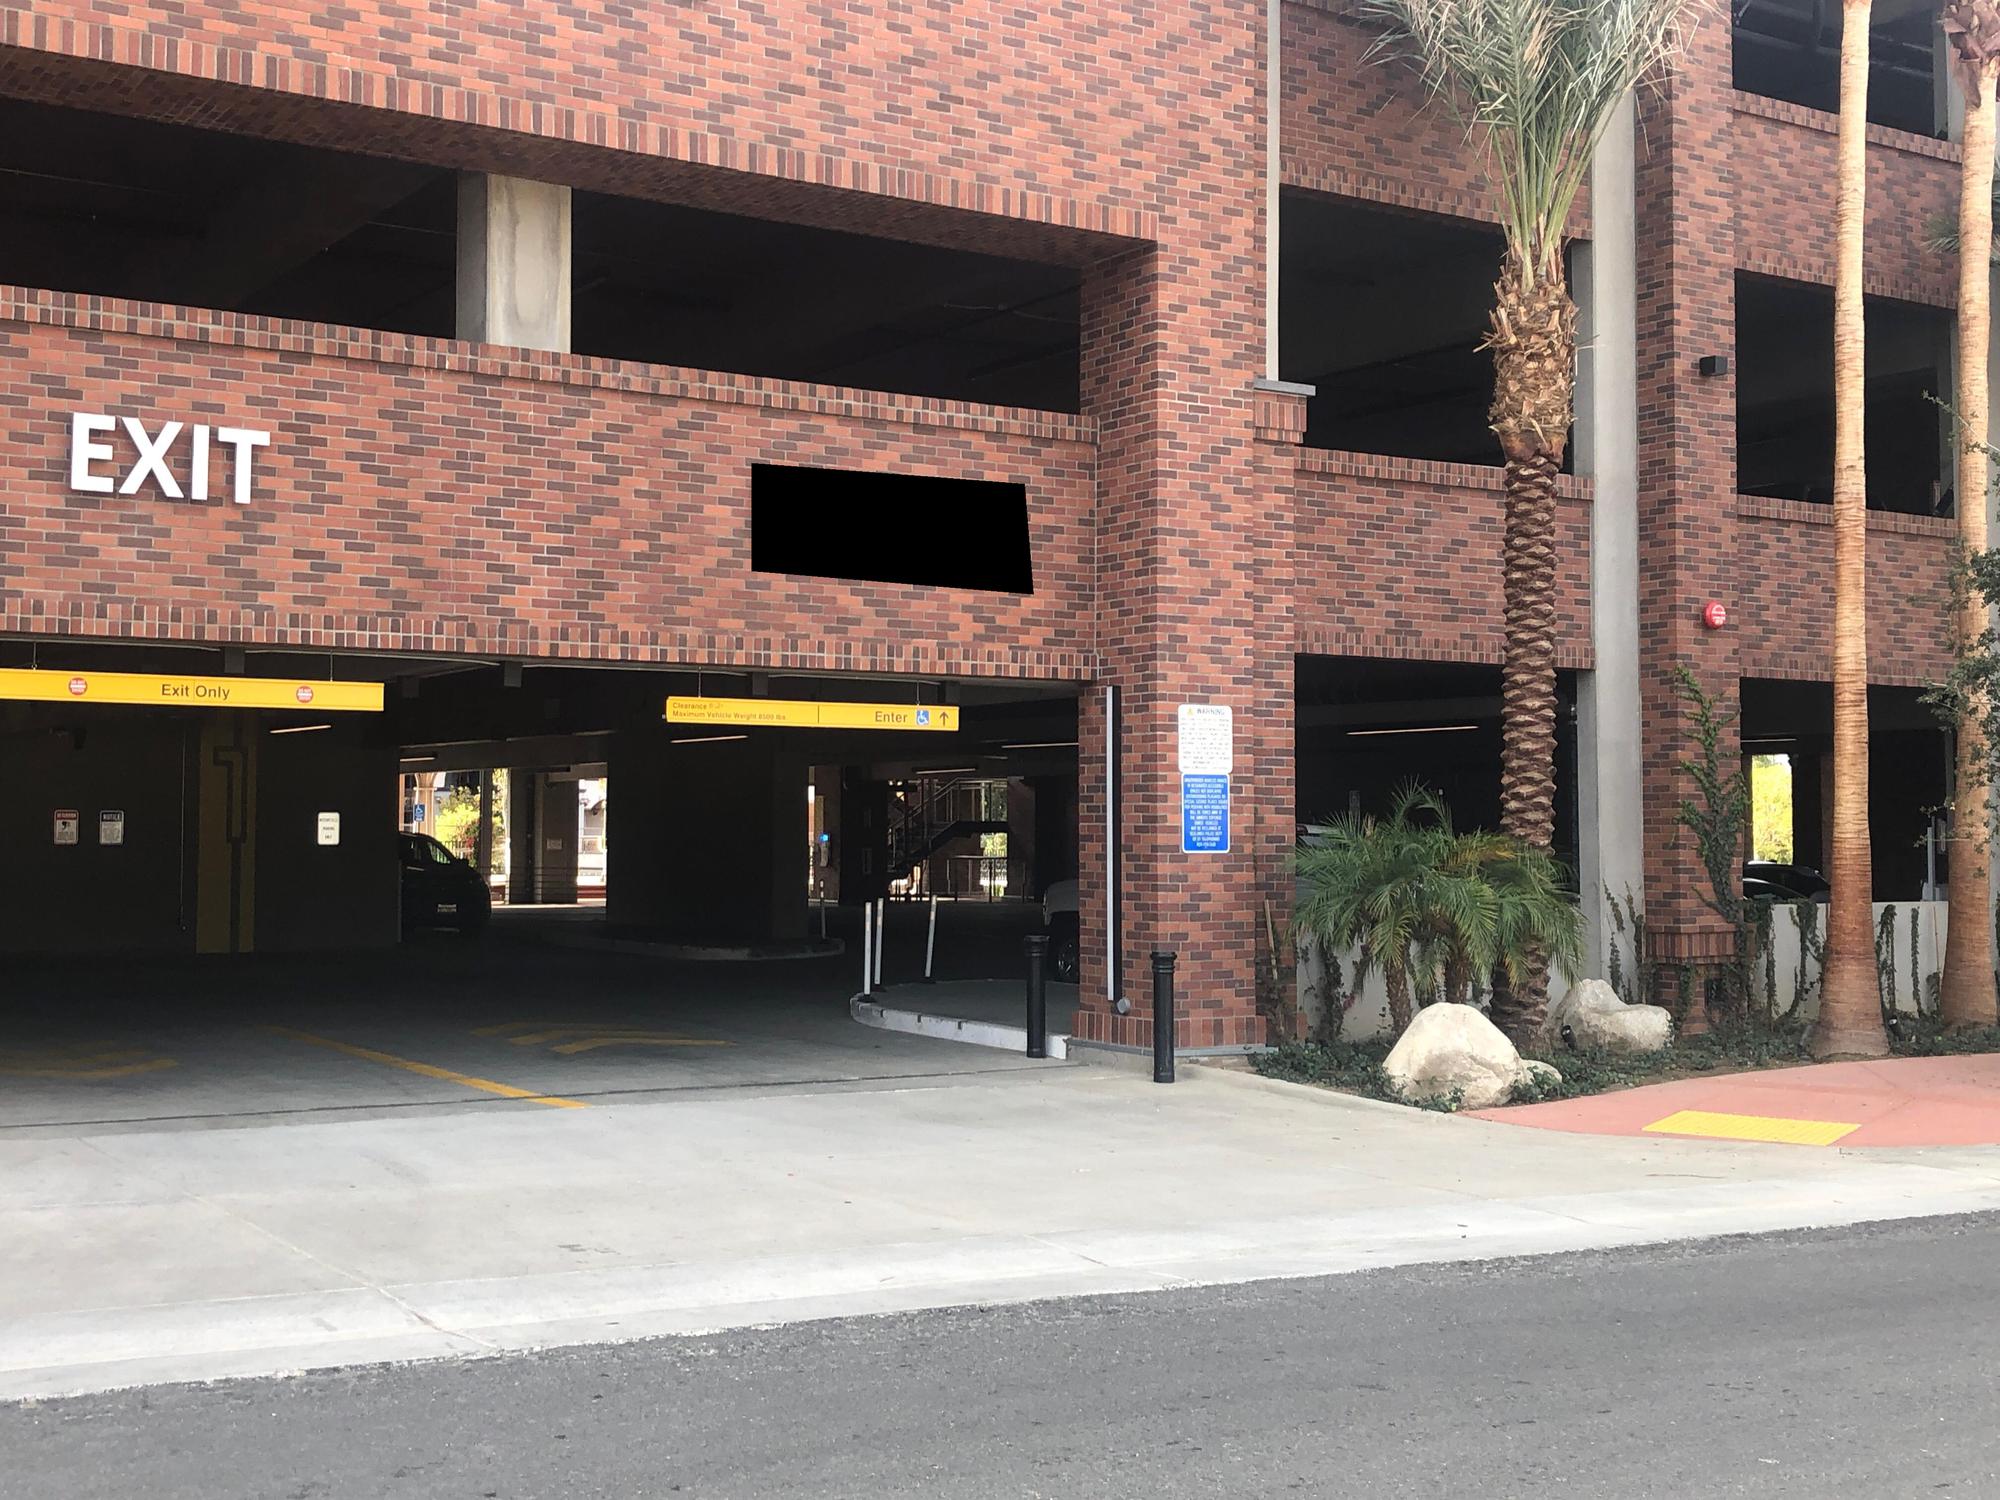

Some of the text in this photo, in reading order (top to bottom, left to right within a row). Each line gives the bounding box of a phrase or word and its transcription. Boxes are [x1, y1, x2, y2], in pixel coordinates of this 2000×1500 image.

[71, 412, 271, 504] EXIT
[161, 683, 230, 701] Exit Only
[672, 702, 707, 710] Clearance
[672, 710, 706, 718] Maximum
[707, 711, 732, 719] Vehicle
[733, 712, 757, 721] Weight
[875, 710, 908, 723] Enter
